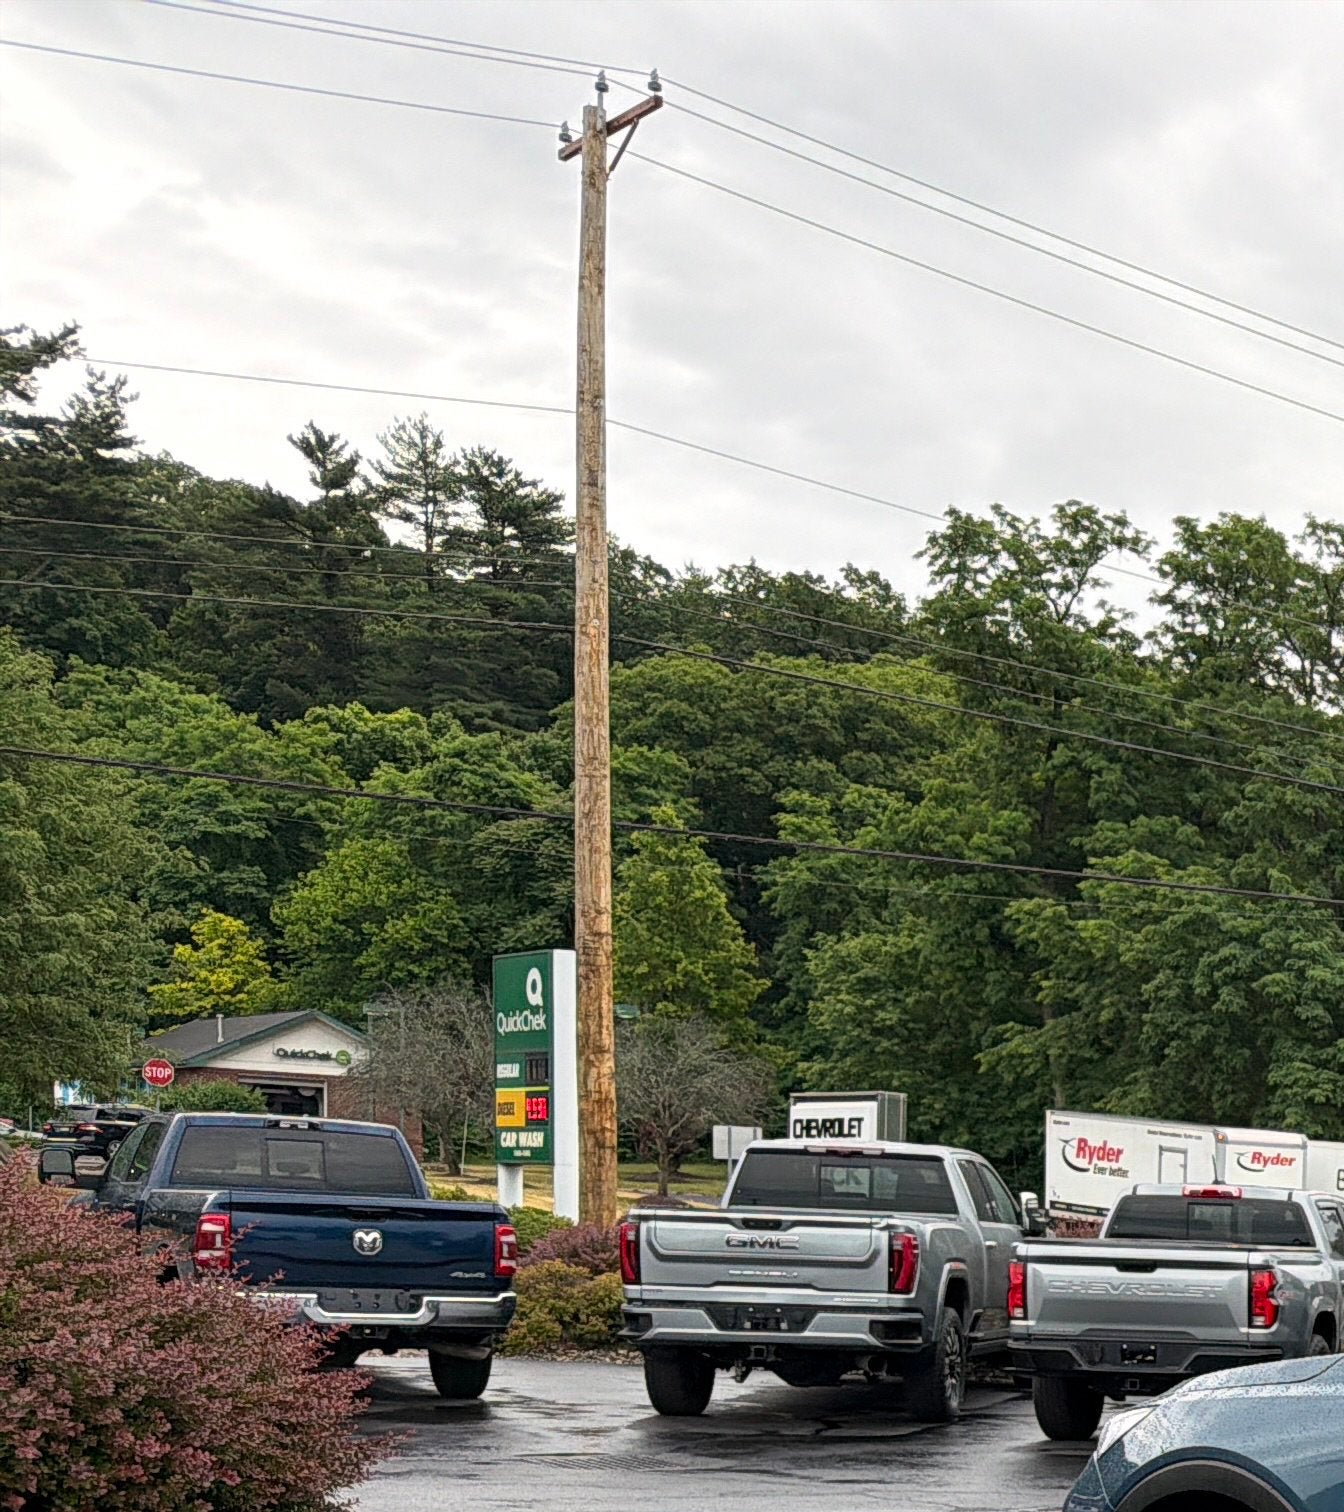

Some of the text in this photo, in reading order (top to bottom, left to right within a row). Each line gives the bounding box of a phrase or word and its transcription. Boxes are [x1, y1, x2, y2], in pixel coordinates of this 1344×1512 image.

[526, 967, 544, 1006] Q
[497, 1008, 547, 1036] QuickChek
[144, 1065, 172, 1078] STOP
[793, 1118, 864, 1138] CHEVROLET
[501, 1131, 544, 1147] CAR WASH
[1076, 1137, 1124, 1164] Ryder
[1251, 1151, 1296, 1167] Ryder
[1093, 1163, 1107, 1175] Ever
[725, 1233, 800, 1250] GMC
[1048, 1279, 1223, 1298] CHEVROLET
